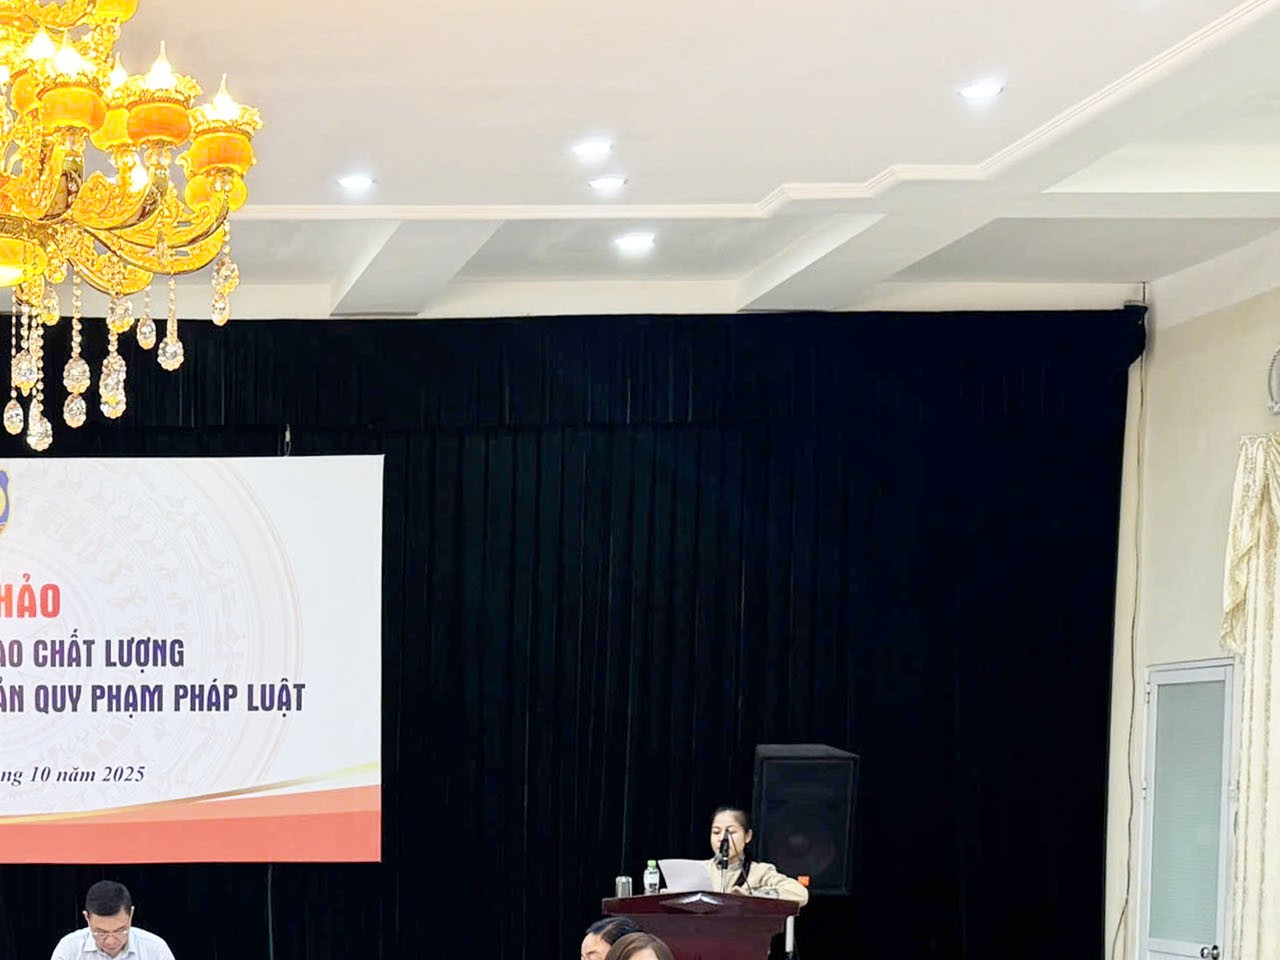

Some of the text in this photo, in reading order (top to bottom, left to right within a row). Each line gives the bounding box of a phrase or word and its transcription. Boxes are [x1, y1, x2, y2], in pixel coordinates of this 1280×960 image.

[33, 628, 96, 668] CHẤT
[105, 636, 185, 674] LƯỢNG
[34, 684, 82, 715] QUY
[91, 684, 164, 719] PHẠM
[173, 678, 238, 712] PHÁP
[247, 677, 306, 718] LUẬT
[31, 766, 51, 782] 10
[56, 766, 96, 782] năm
[102, 765, 146, 782] 2025
